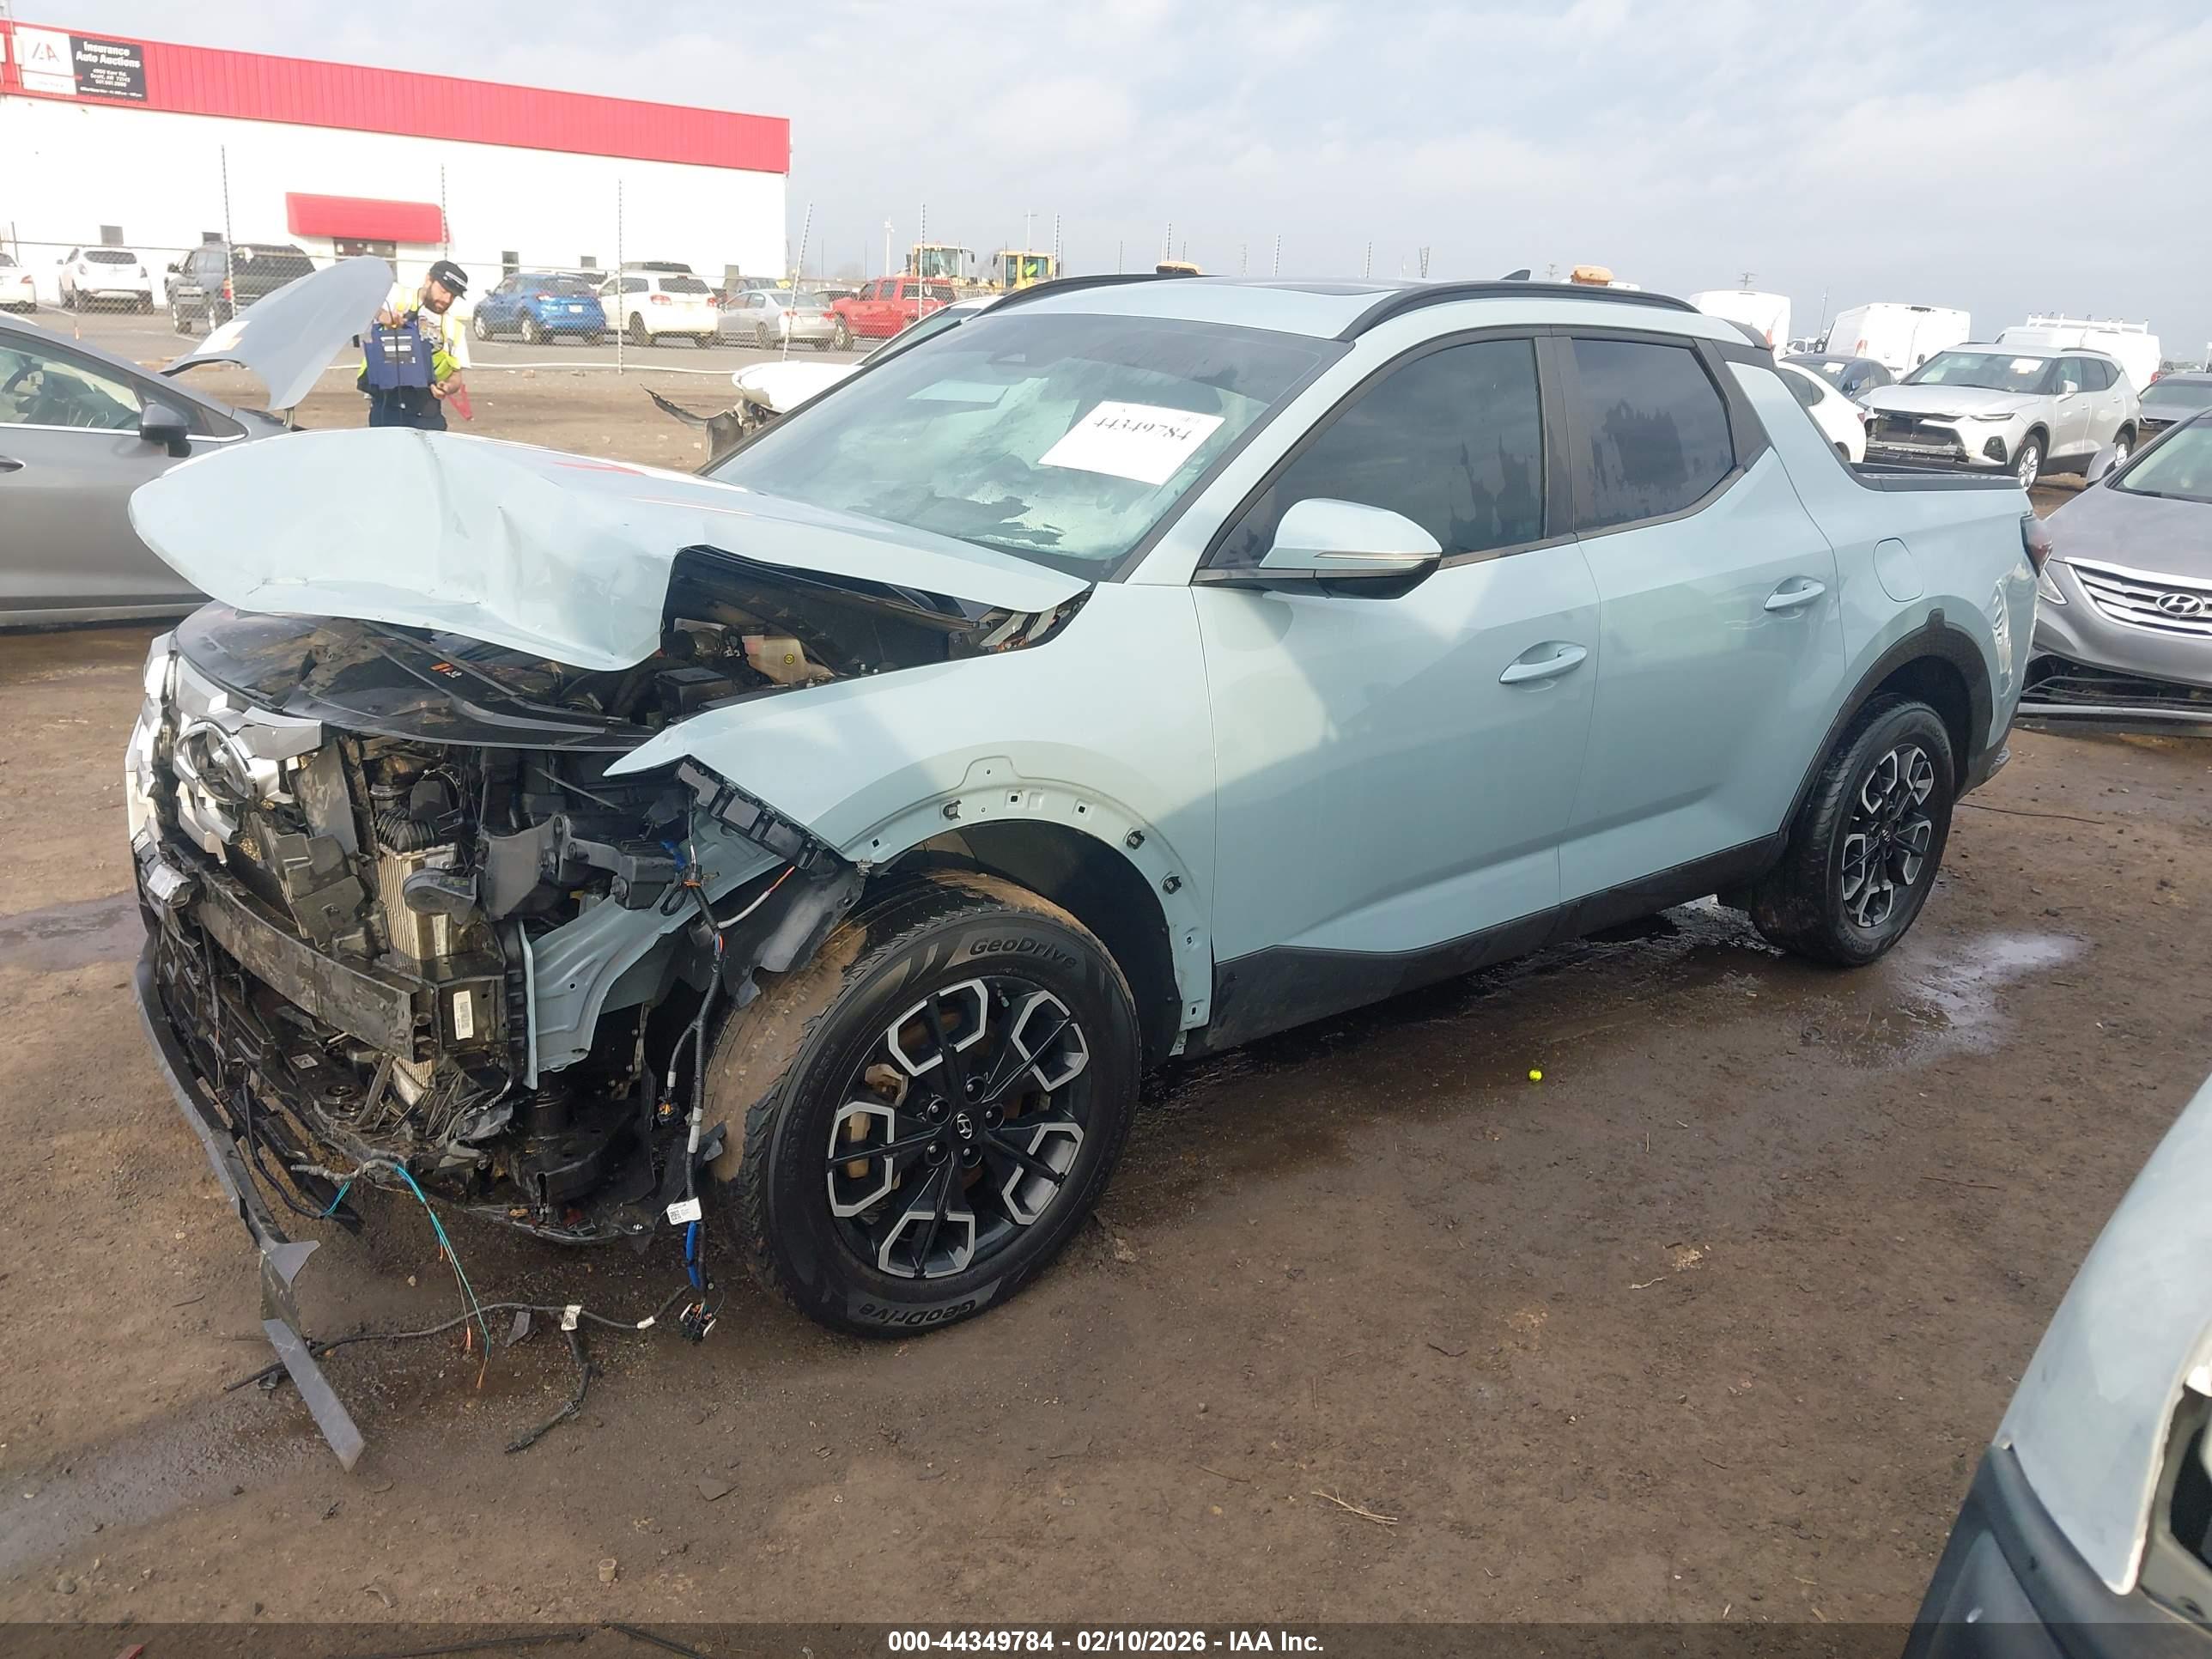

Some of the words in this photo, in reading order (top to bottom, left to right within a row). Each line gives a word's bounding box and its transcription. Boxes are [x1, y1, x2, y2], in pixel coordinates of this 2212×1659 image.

[76, 51, 99, 63] Auto
[100, 53, 141, 68] Auctions
[83, 40, 131, 57] Insurance
[1092, 417, 1193, 441] 44349784
[969, 937, 1079, 969] GeoDrive
[858, 1299, 976, 1326] GeoDrive
